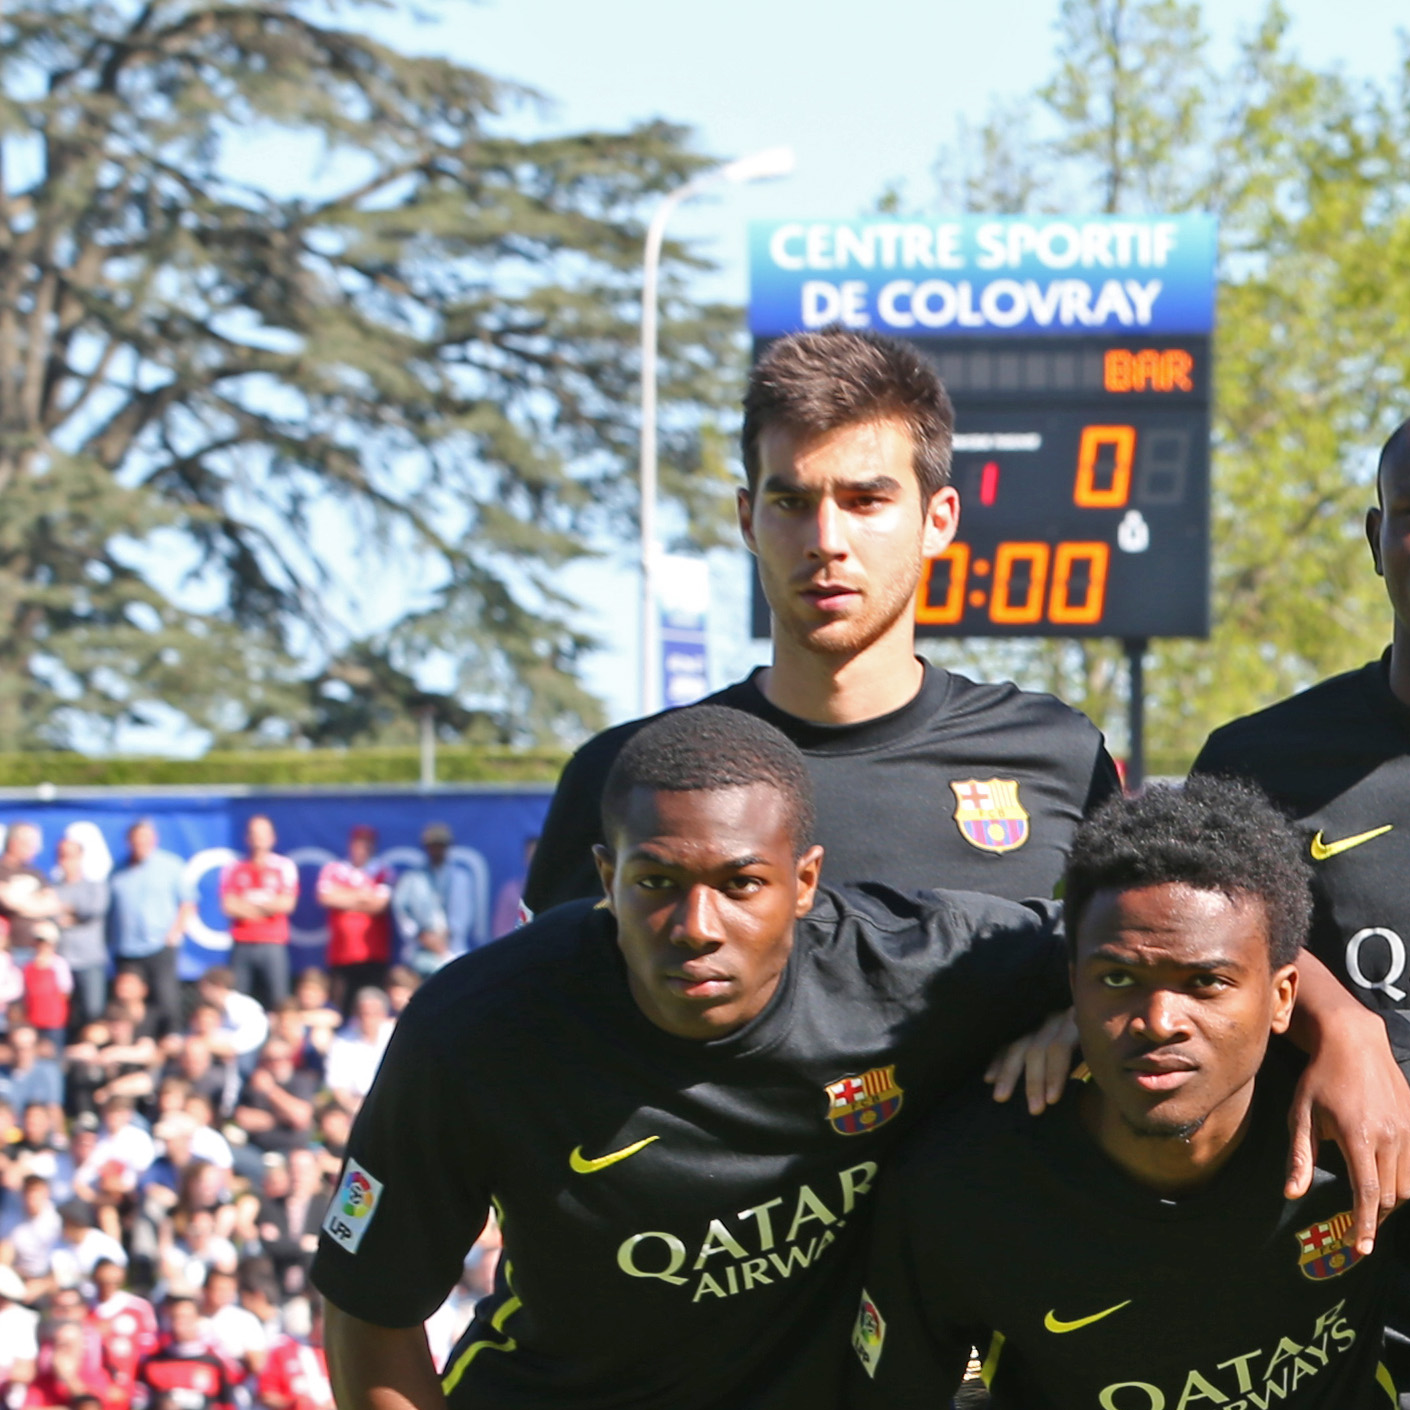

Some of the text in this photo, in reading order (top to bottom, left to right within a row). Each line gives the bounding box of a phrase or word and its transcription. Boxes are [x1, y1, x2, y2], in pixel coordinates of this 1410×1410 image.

[769, 222, 1179, 270] CENTRE SPORTIF
[801, 278, 1163, 328] DE COLOVRAY
[1104, 348, 1195, 393] BAR
[1073, 425, 1136, 509] 0
[616, 1161, 878, 1286] QATAR
